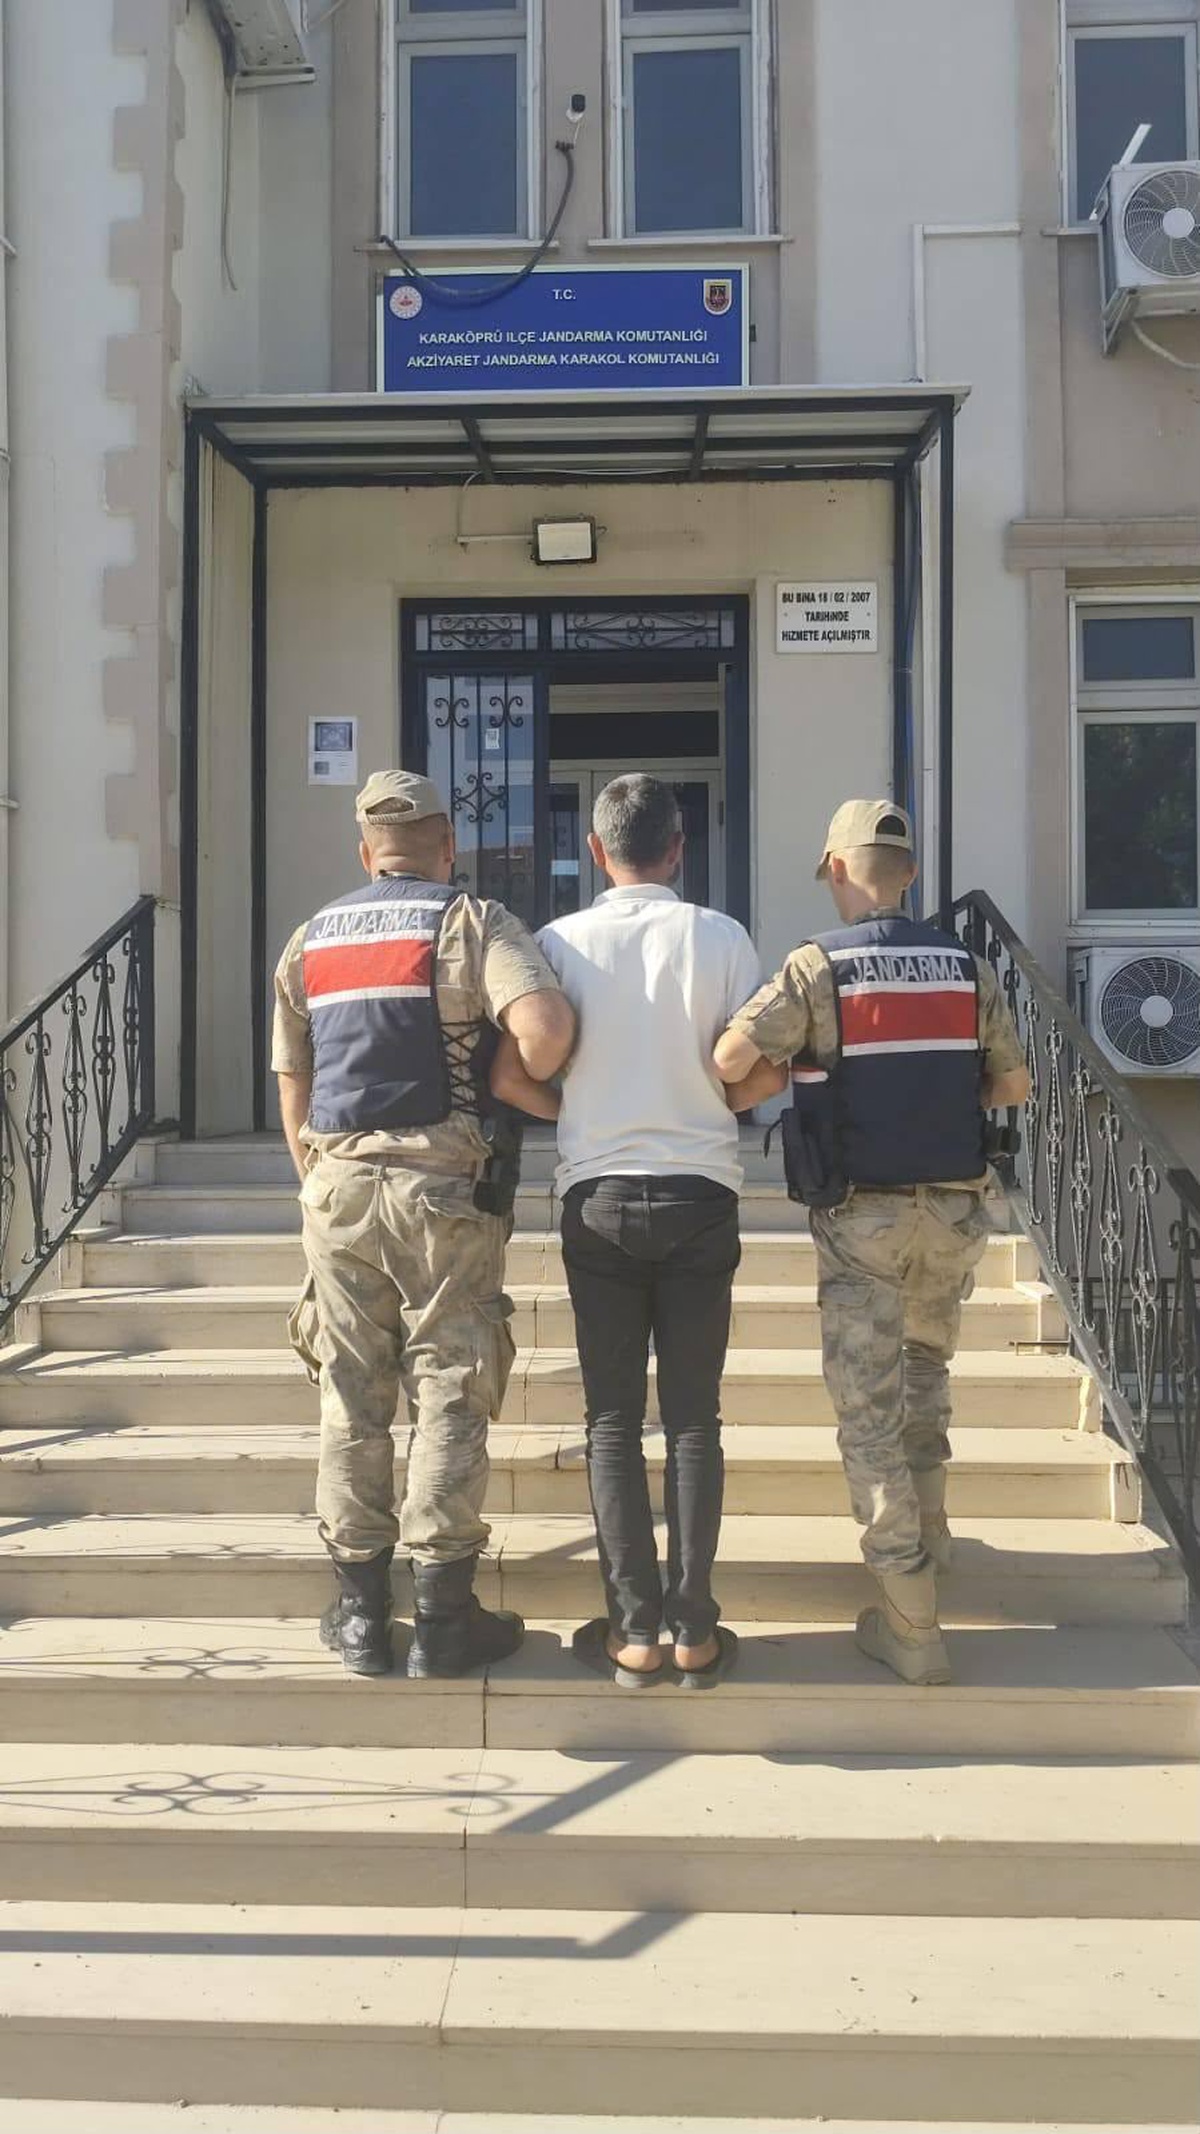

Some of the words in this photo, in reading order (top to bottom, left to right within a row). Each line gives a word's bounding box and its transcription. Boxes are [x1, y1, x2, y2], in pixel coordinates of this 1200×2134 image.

[552, 289, 577, 300] T.C.
[419, 329, 503, 344] KARAKÖPRÜ
[538, 330, 613, 343] JANDARMA
[616, 328, 708, 342] KOMUTANLIĞI
[407, 353, 480, 367] AKZİYARET
[482, 354, 558, 366] JANDARMA
[560, 353, 626, 365] KARAKOL
[628, 351, 720, 365] KOMUTANLIĞI
[782, 592, 794, 603] BU
[834, 592, 845, 603] 02
[851, 591, 871, 603] 2007
[315, 907, 422, 939] JANDARMA
[849, 956, 966, 984] JANDARMA
